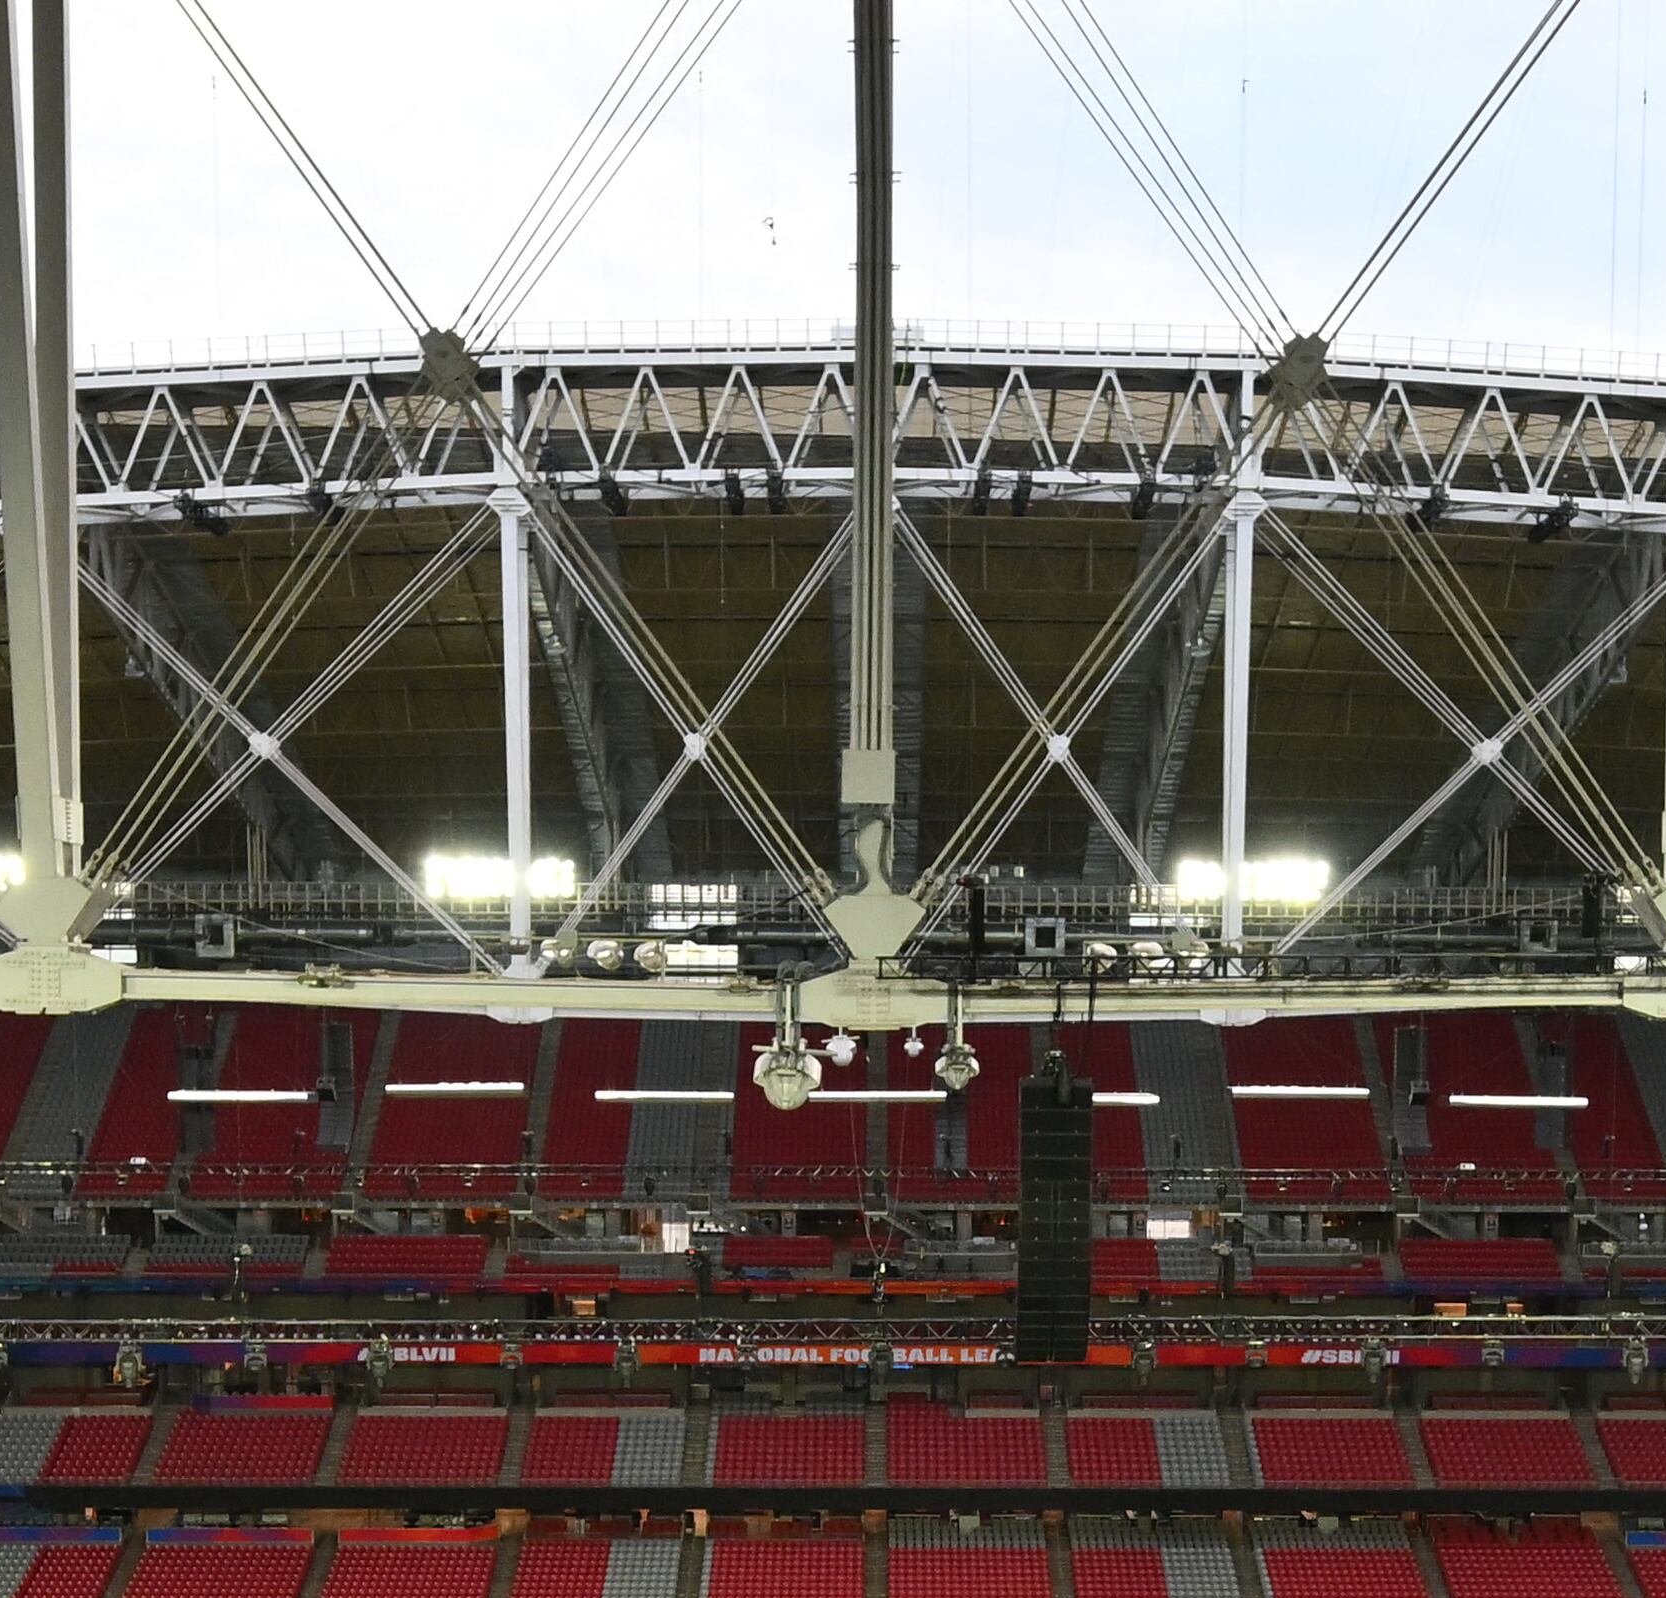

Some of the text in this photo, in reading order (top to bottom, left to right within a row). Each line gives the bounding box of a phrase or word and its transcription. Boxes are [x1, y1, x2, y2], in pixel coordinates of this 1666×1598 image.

[357, 1347, 455, 1361] BLVII
[699, 1348, 823, 1362] NAONAL
[830, 1348, 953, 1362] FOOBALL
